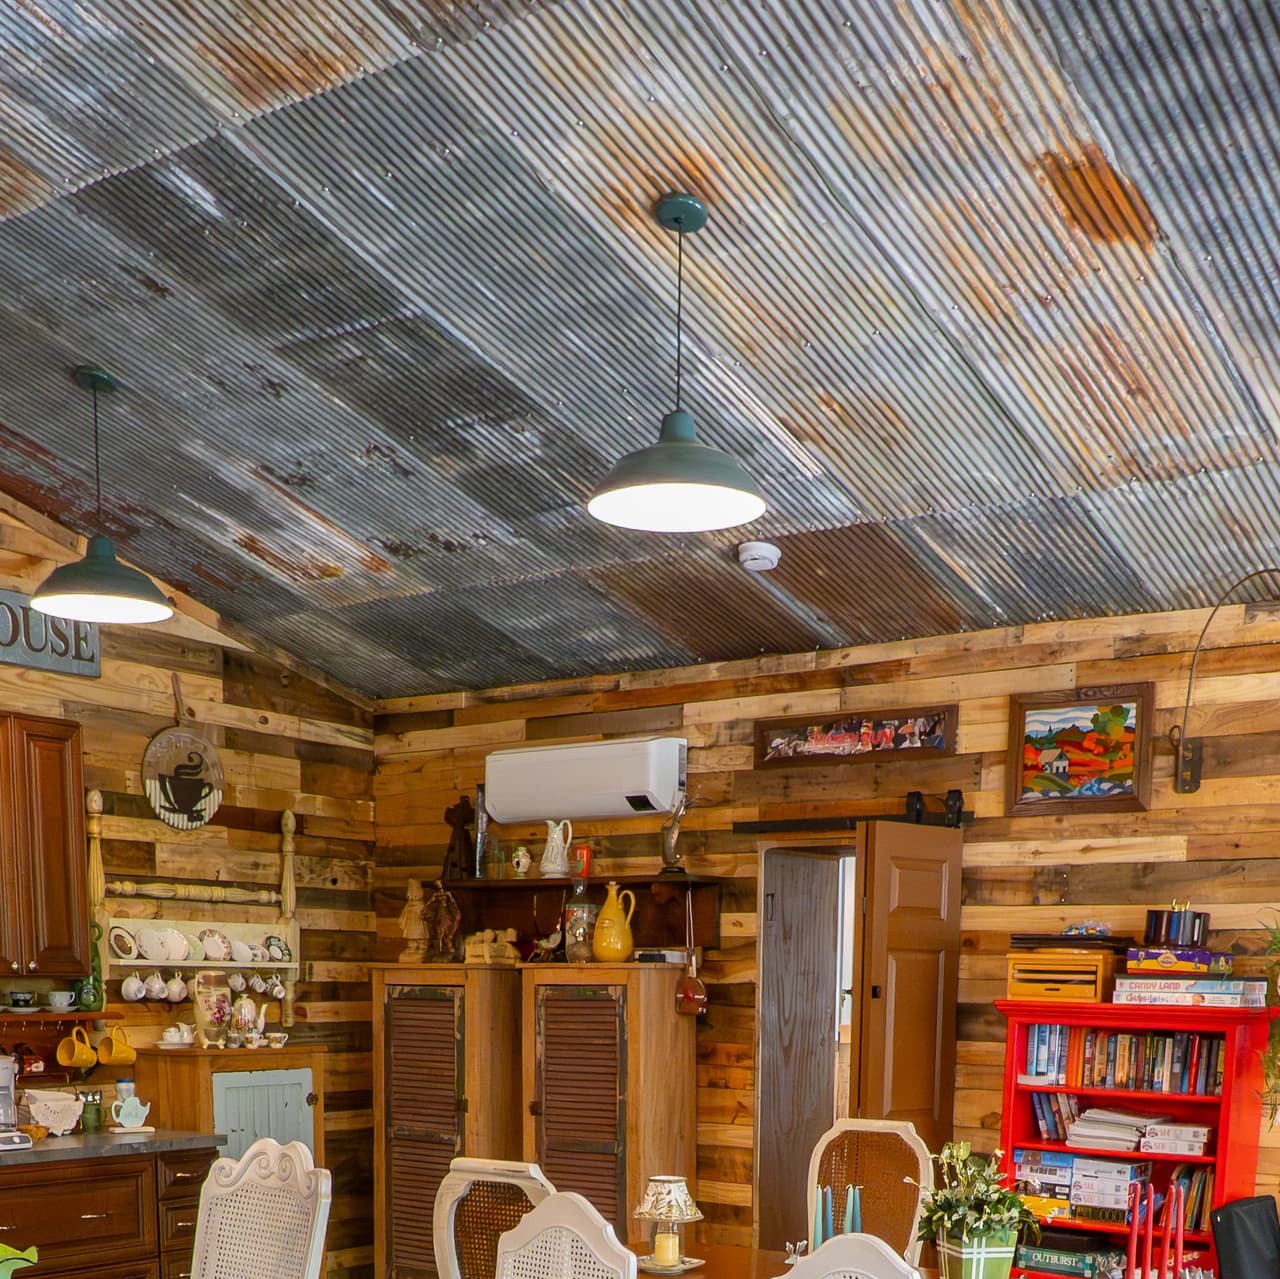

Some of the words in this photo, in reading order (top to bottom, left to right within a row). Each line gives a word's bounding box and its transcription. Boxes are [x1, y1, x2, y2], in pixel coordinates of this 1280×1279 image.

[861, 729, 893, 745] RUN
[1128, 980, 1157, 990] CANDY
[1158, 980, 1181, 991] LAND
[1032, 1251, 1079, 1267] OUTBURST
